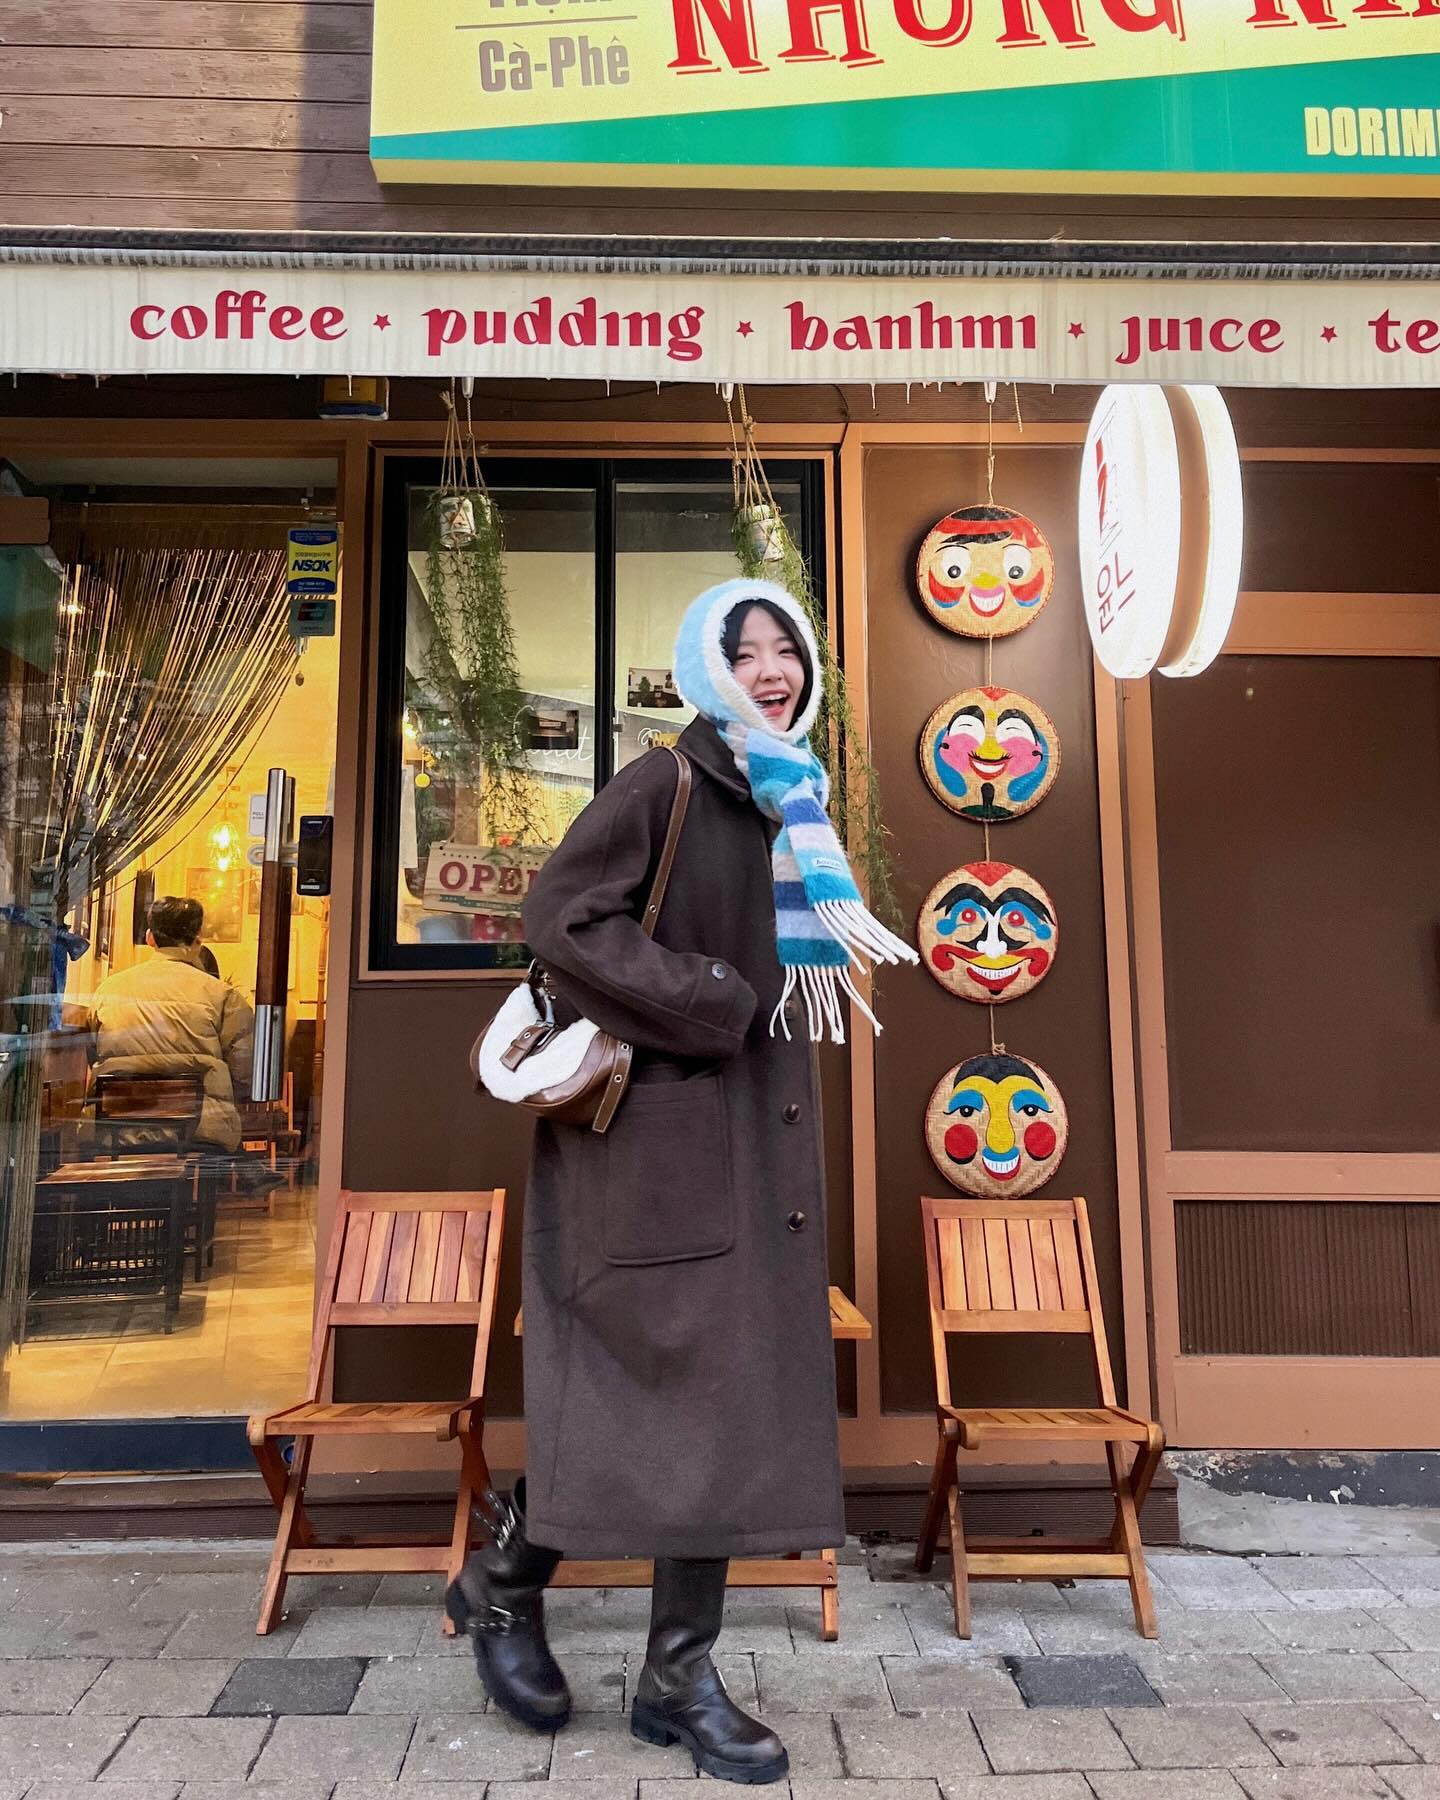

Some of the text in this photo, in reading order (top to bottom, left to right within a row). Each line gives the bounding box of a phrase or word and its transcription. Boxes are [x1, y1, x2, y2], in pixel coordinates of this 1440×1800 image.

[479, 35, 630, 92] Cà-Phê
[1304, 107, 1440, 157] DORIM
[130, 290, 347, 340] coffee
[422, 297, 704, 362] pudding
[785, 301, 1036, 351] banhmi
[1116, 316, 1285, 365] juice
[291, 559, 332, 572] NSOK
